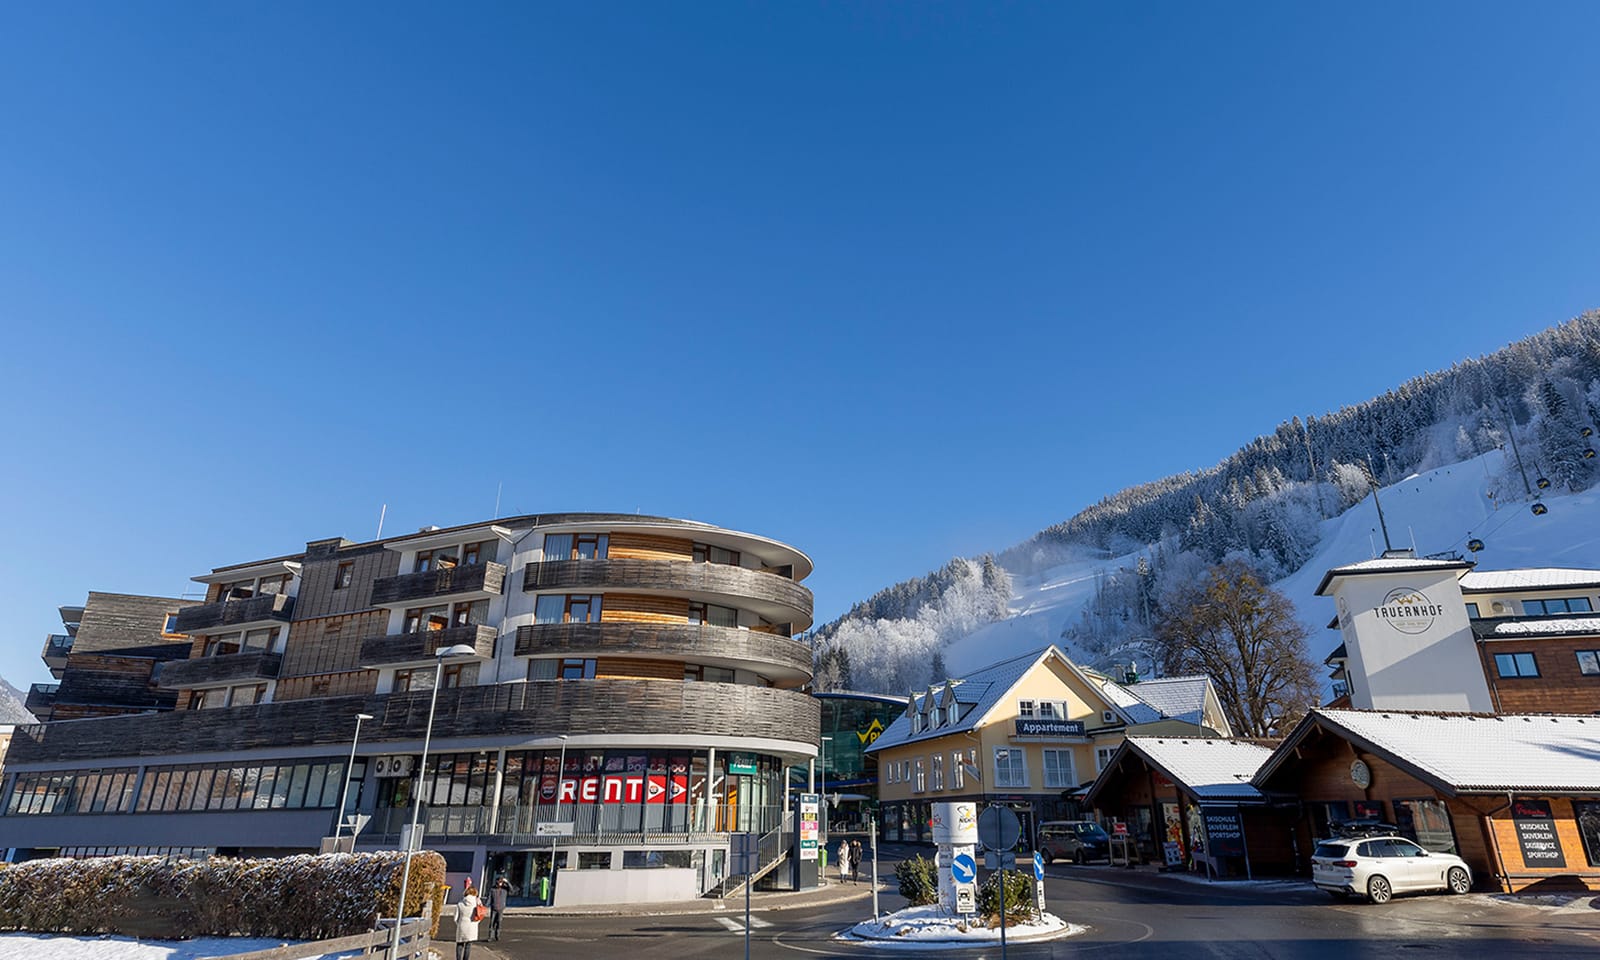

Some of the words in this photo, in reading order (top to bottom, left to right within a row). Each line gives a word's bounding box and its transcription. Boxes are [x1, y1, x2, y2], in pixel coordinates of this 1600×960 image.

[1374, 605, 1442, 618] TAUERNHOF
[1023, 723, 1078, 733] Appartement
[559, 778, 644, 800] RENT
[1527, 851, 1559, 859] SPORTSHOP
